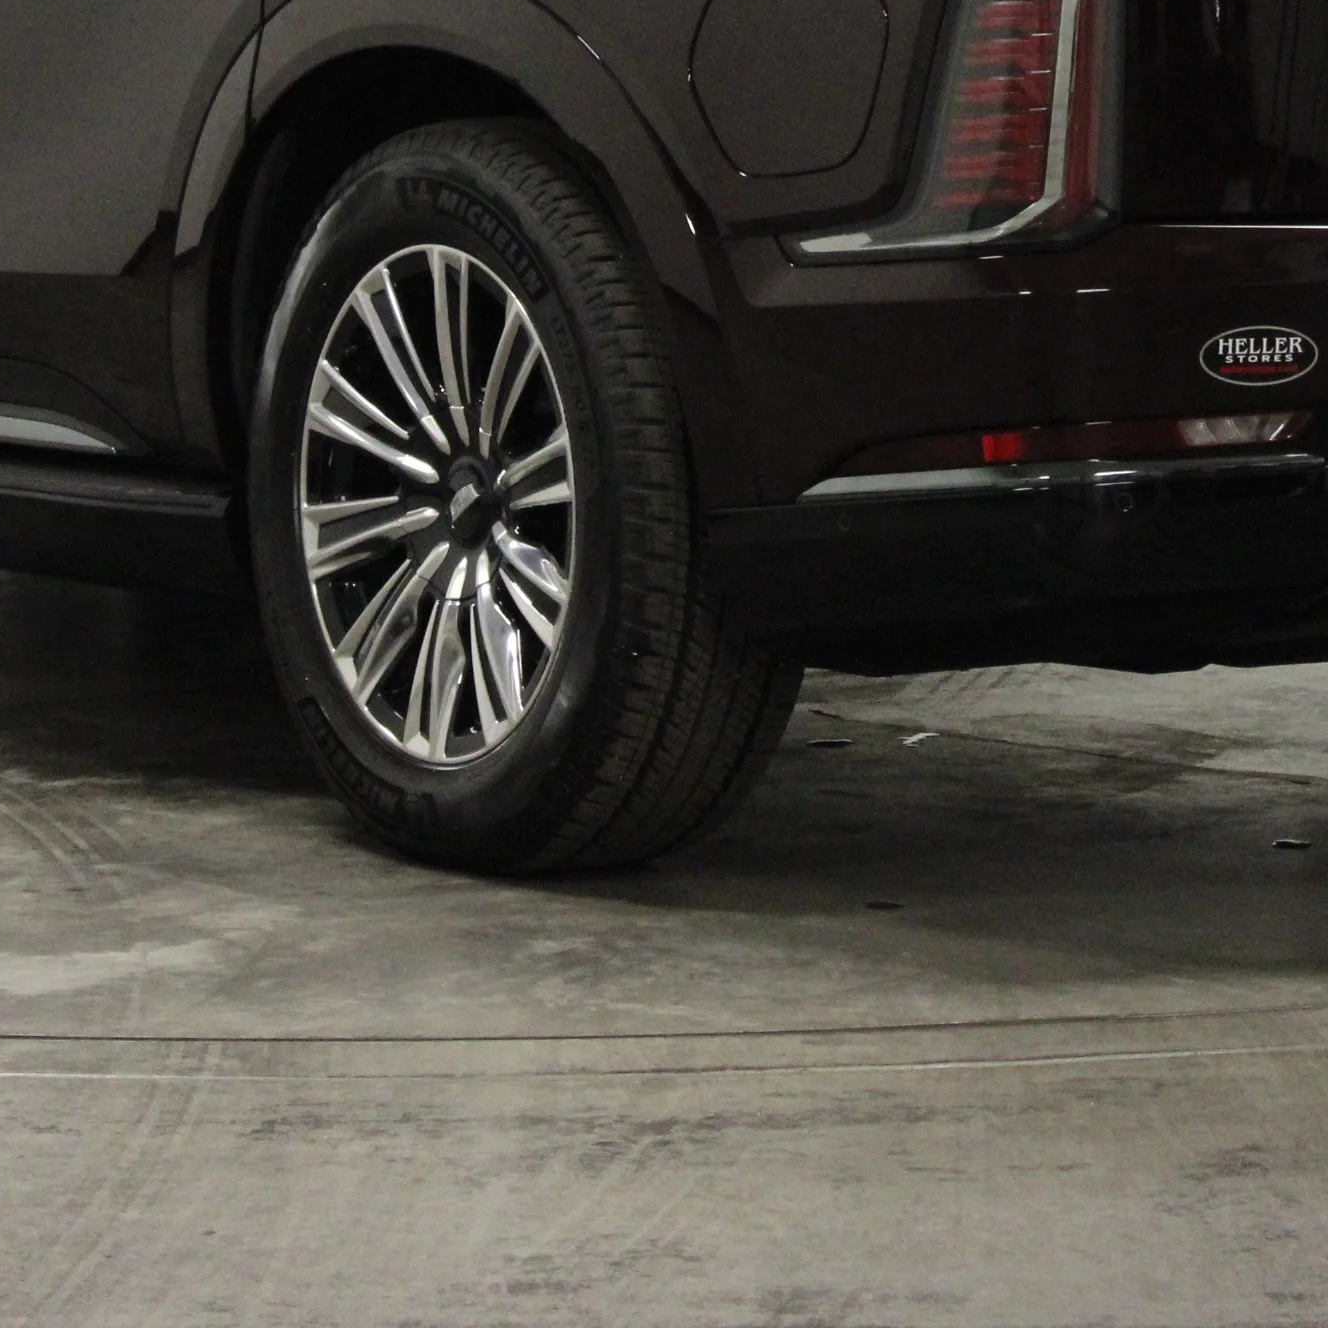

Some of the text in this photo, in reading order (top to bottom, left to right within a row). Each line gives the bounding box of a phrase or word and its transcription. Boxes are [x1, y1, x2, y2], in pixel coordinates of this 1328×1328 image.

[437, 187, 543, 296] MICHELIN
[1218, 337, 1303, 354] HELLER
[1225, 354, 1293, 363] STORES
